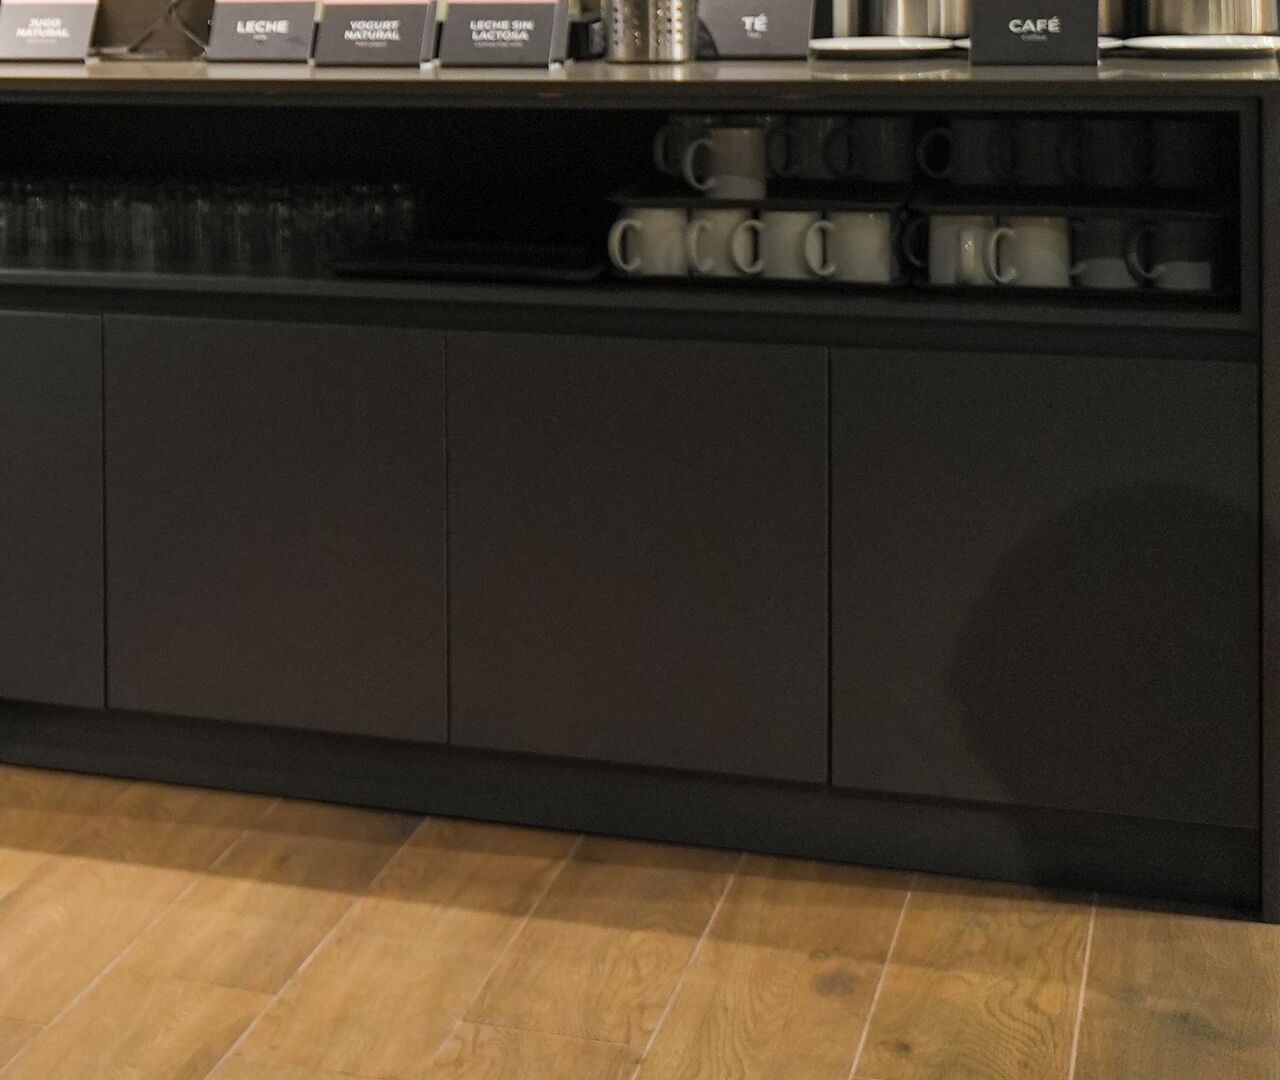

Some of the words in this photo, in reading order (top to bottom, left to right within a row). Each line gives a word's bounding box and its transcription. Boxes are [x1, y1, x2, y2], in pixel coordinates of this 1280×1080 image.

[236, 20, 289, 34] LECHE
[349, 20, 400, 30] YOGURT
[469, 20, 510, 30] LECHE
[511, 20, 535, 30] SIN
[741, 13, 768, 32] TÉ
[1008, 15, 1061, 33] CAFÉ
[15, 27, 70, 38] NATURAL
[343, 30, 400, 41] NATURAL
[471, 30, 530, 41] LACTOSA
